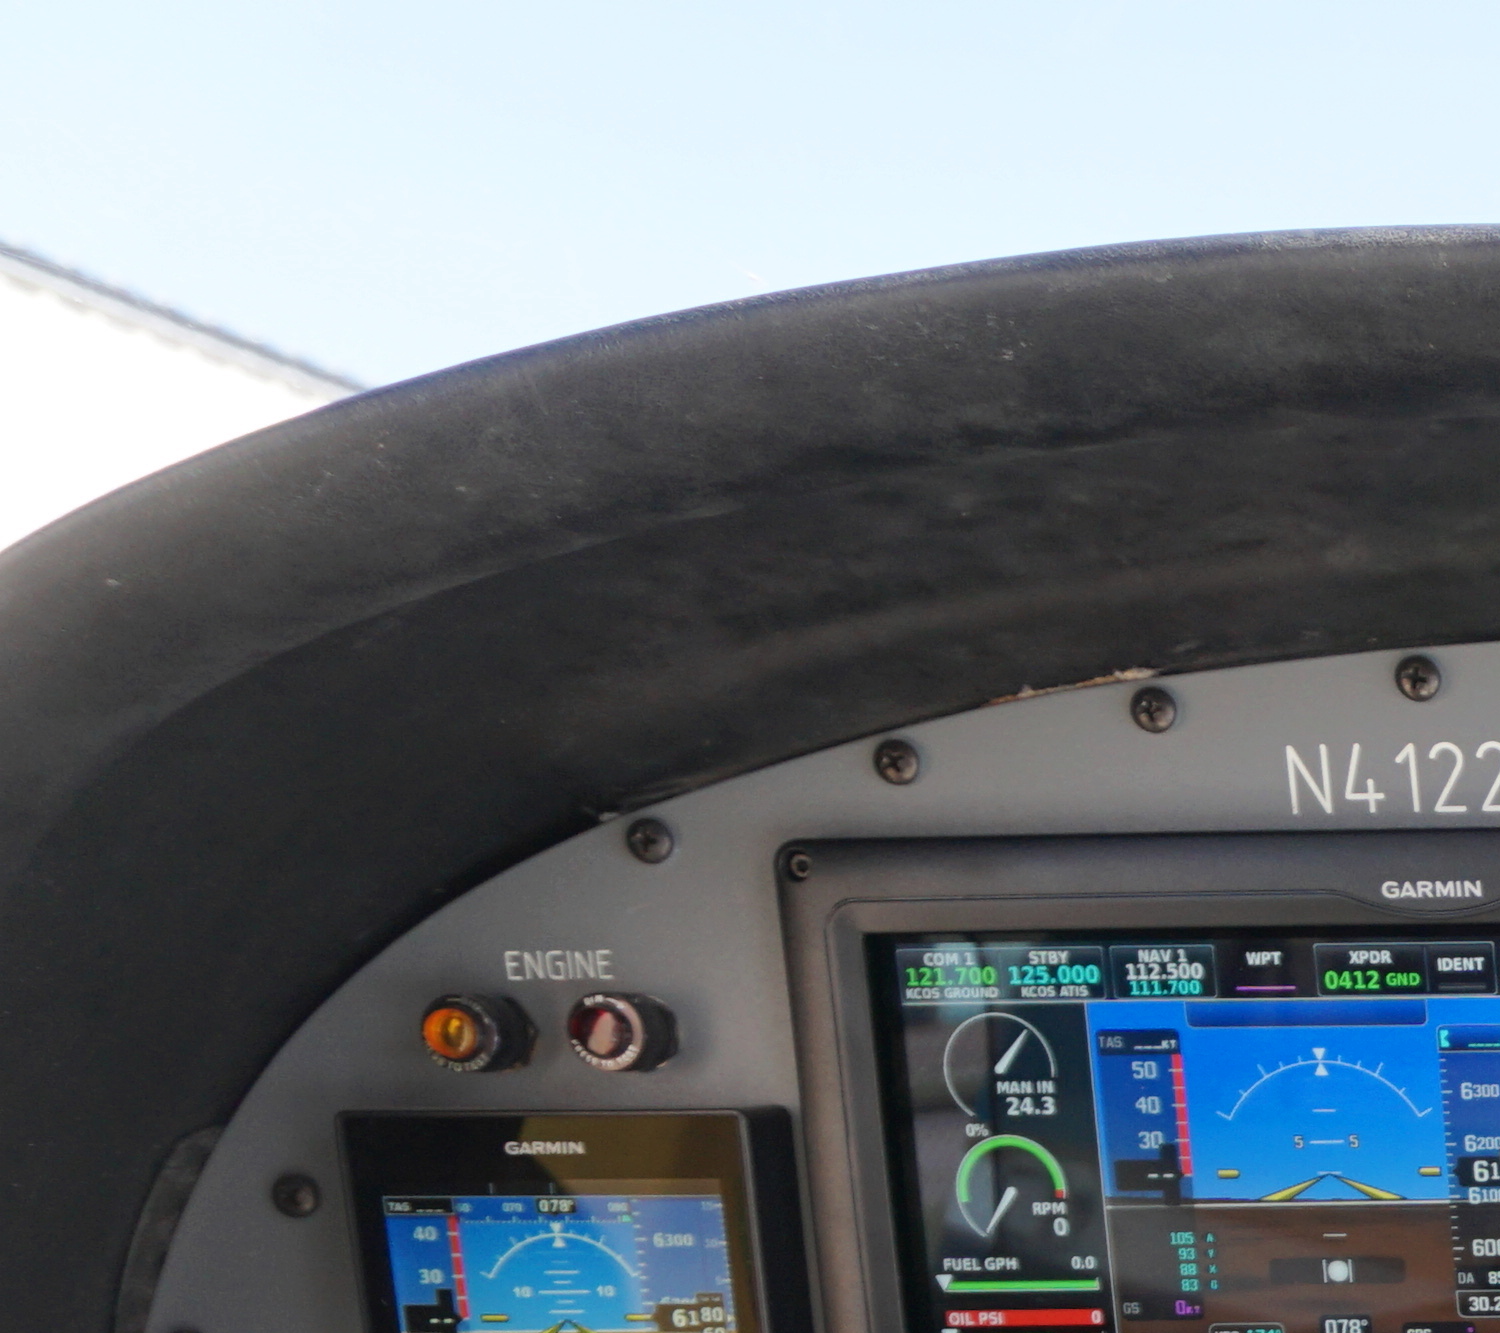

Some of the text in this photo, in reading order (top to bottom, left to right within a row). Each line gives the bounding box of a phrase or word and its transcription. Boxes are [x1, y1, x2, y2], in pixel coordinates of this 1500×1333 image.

[1381, 880, 1482, 898] GARMIN
[505, 949, 614, 981] ENGINE
[1009, 964, 1099, 985] 125.000
[906, 967, 996, 986] 121.700
[1324, 970, 1419, 990] 0412 GND
[504, 1142, 584, 1154] GARMIN
